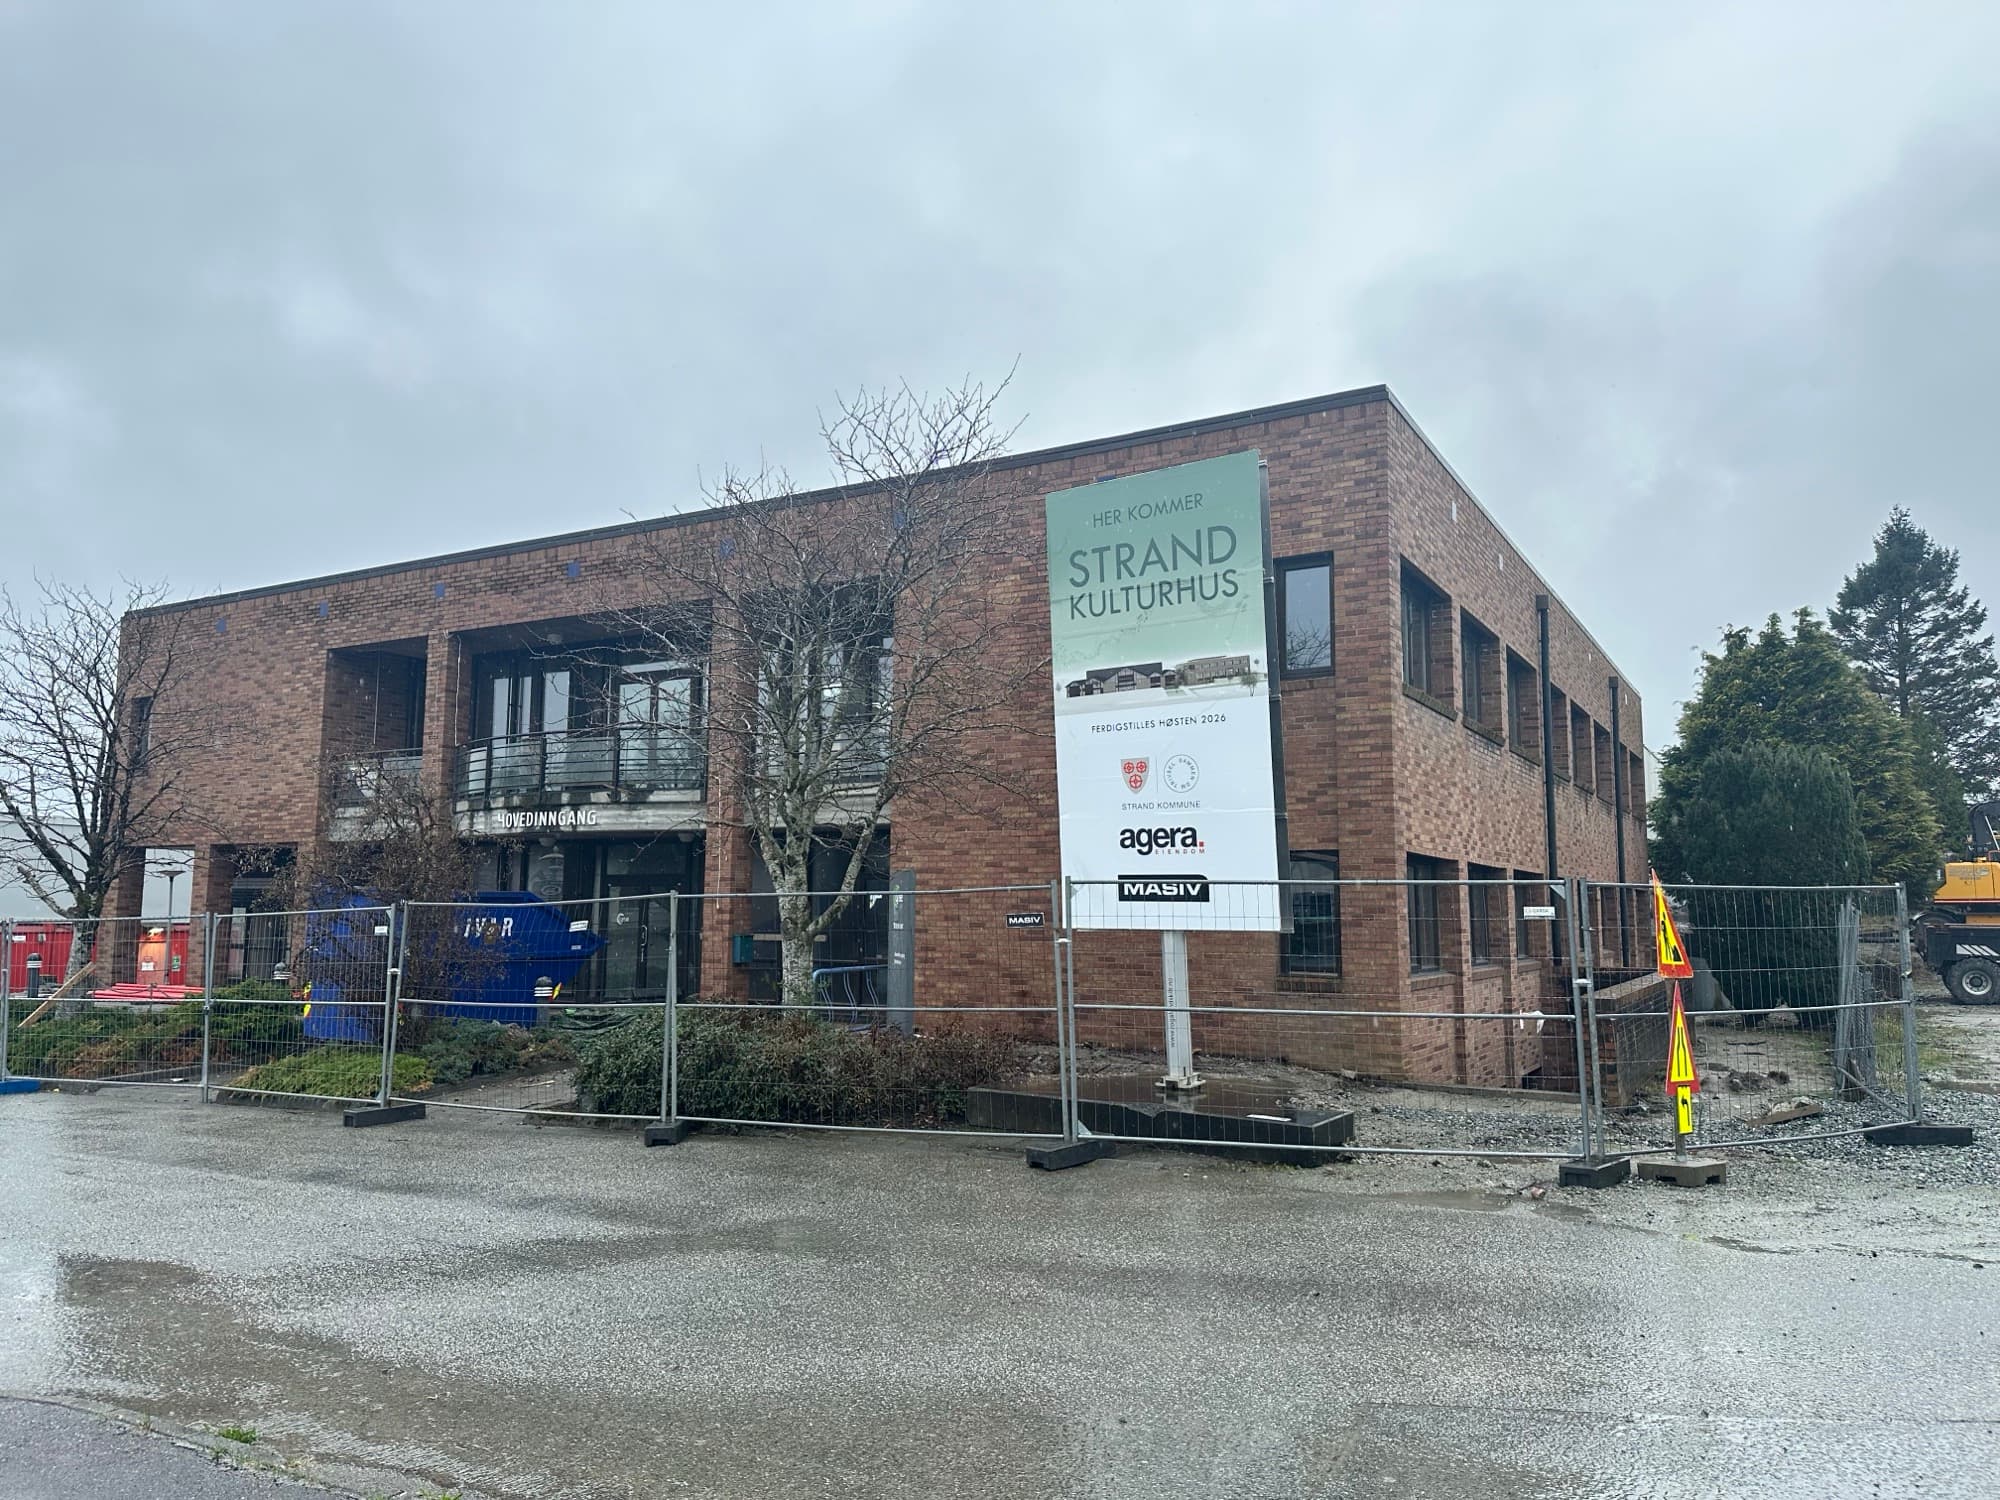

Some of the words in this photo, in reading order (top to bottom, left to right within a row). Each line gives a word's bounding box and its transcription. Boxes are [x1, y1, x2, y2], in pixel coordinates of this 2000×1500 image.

[1093, 509, 1121, 528] HER
[1128, 493, 1203, 520] KOMMER
[1069, 525, 1237, 588] STRAND
[1070, 569, 1239, 620] KULTURHUS
[1091, 720, 1156, 733] FERDIGSTILLES
[1160, 716, 1197, 727] HØSTEN
[1201, 714, 1226, 724] 2026
[1157, 801, 1201, 809] KOMMUNE
[1123, 883, 1202, 896] MASIV
[1009, 916, 1040, 924] MASIV
